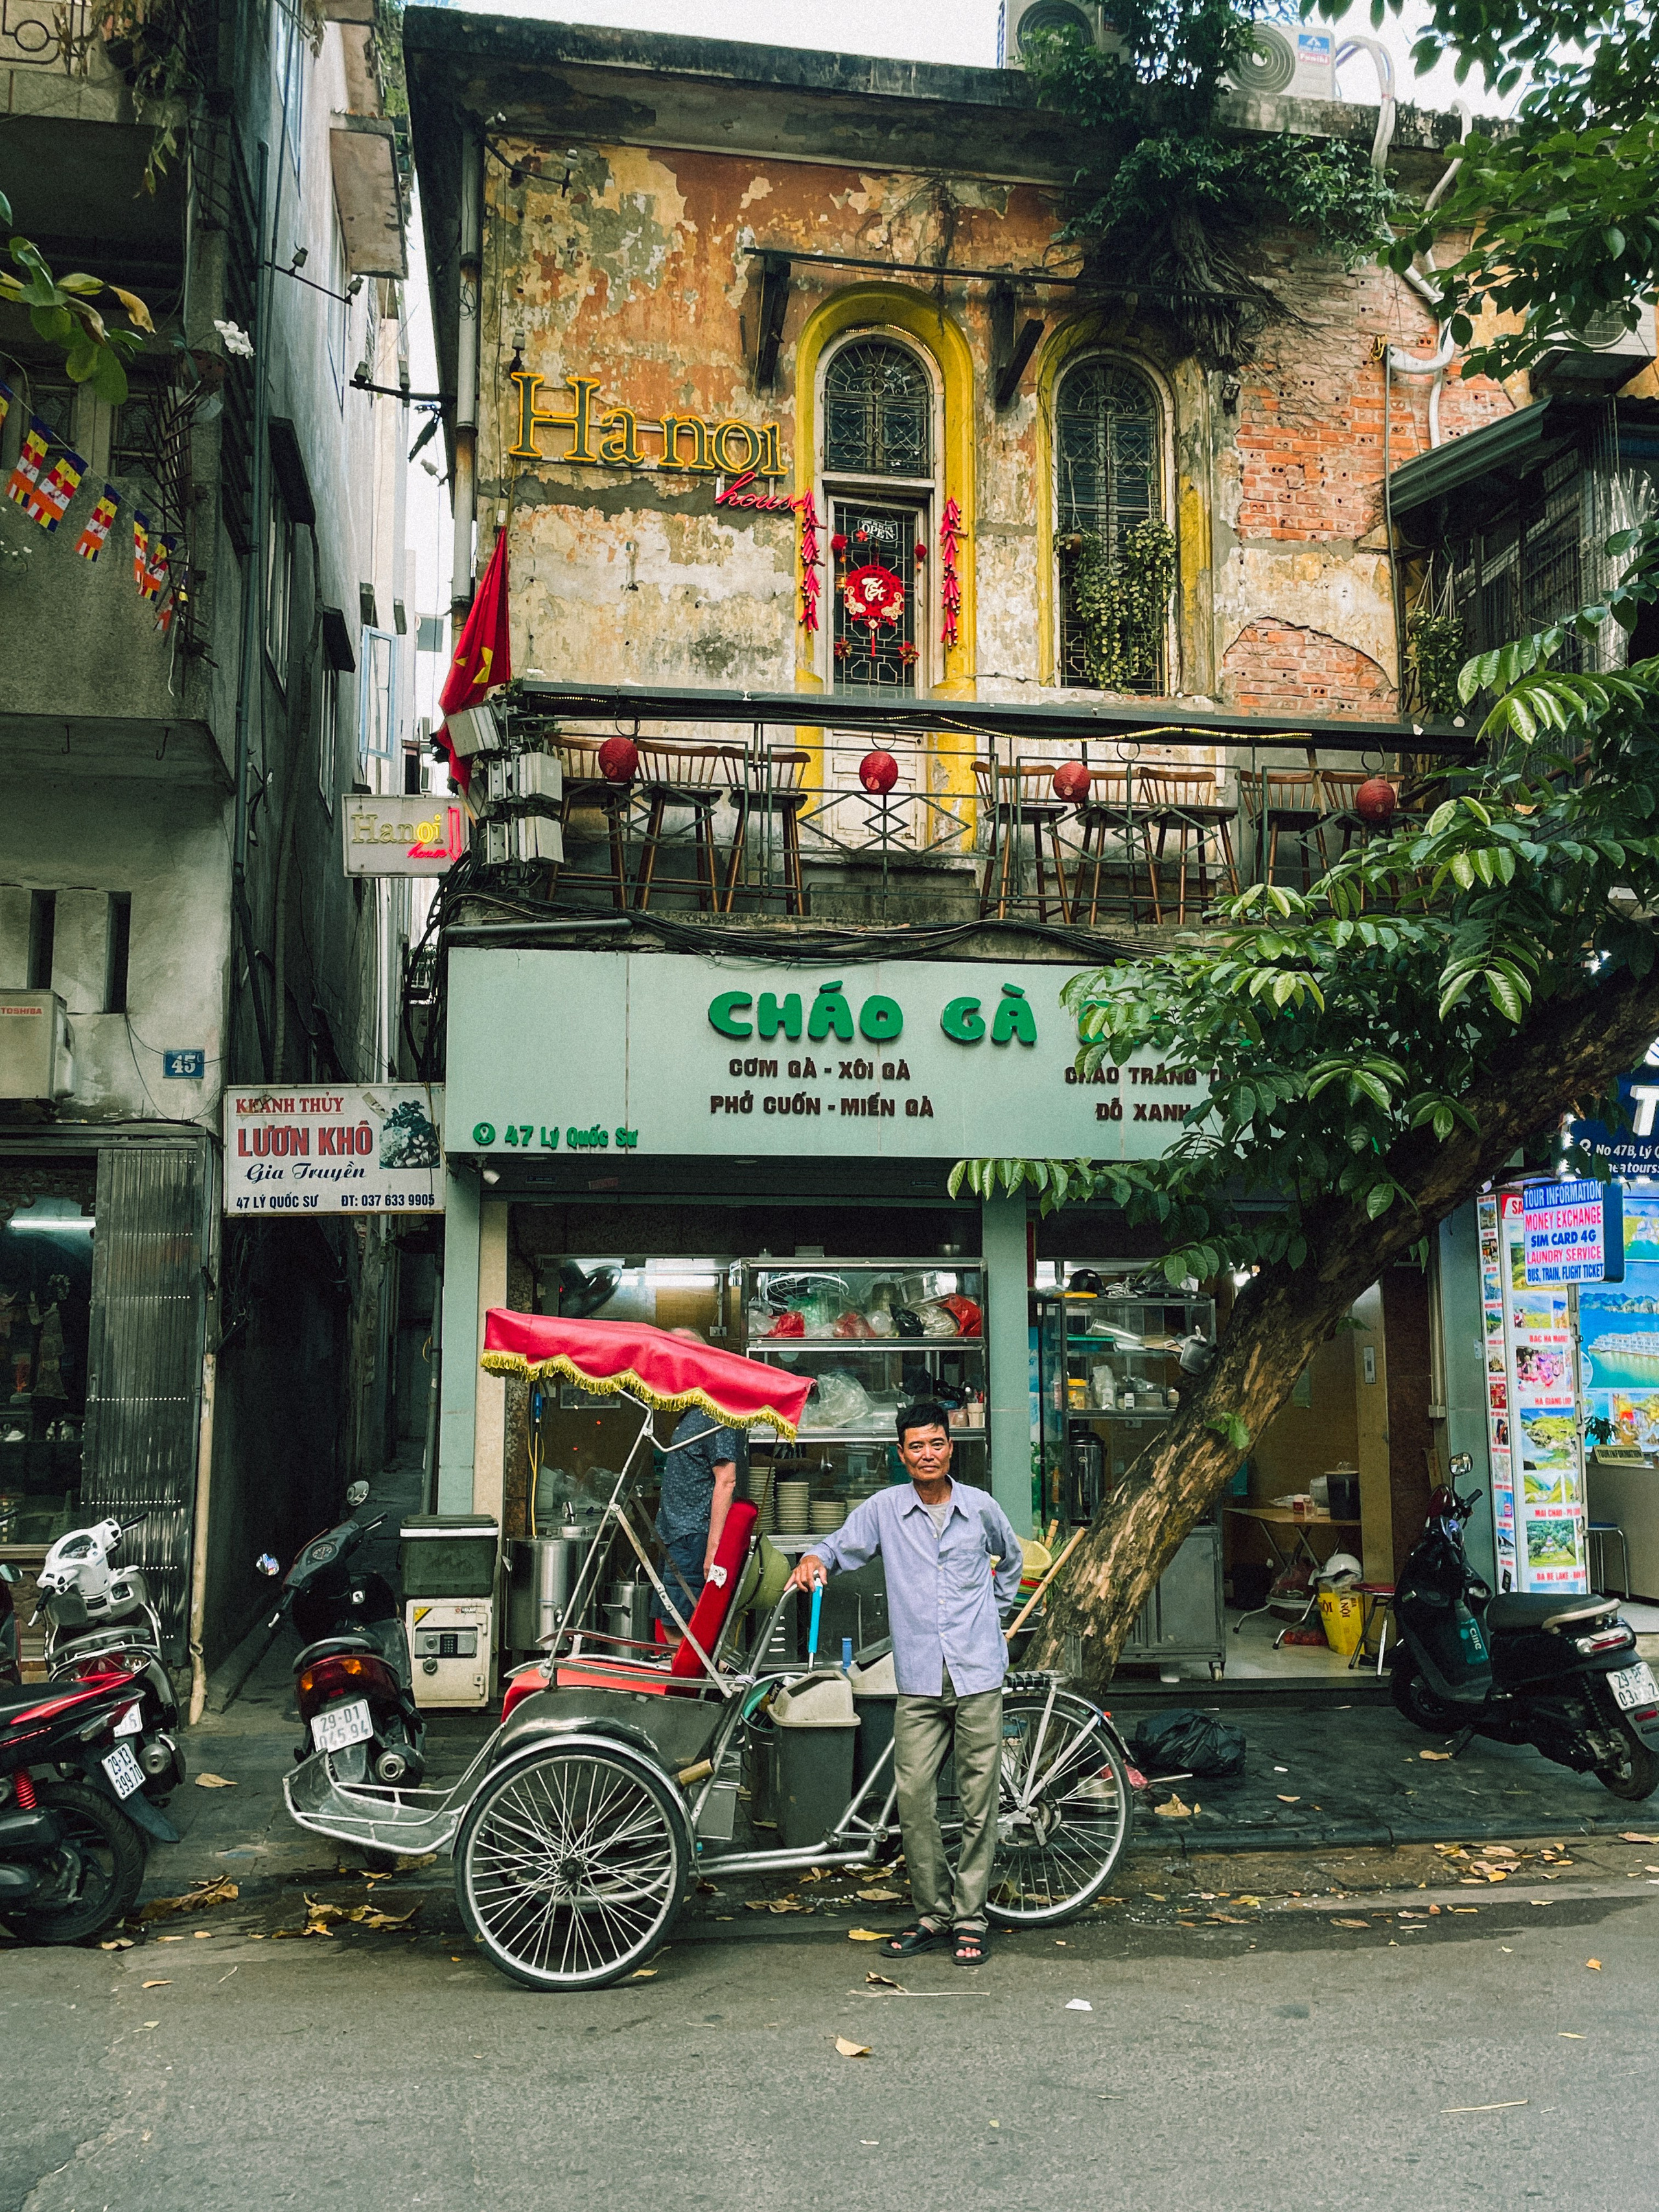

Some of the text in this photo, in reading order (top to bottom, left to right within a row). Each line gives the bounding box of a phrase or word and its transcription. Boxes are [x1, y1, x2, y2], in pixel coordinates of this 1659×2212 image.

[715, 472, 808, 513] house
[862, 523, 894, 539] OPEN
[351, 813, 444, 844] Hanoi
[708, 979, 904, 1042] CHÁO
[941, 982, 1038, 1045] GÀ
[729, 1058, 778, 1077] CƠM
[789, 1057, 817, 1078] GÀ
[839, 1058, 874, 1080] XÔI
[882, 1059, 911, 1080] GÀ
[299, 1092, 345, 1113] THỦY
[710, 1090, 754, 1115] PHỞ
[763, 1091, 820, 1115] CUỐN
[841, 1093, 895, 1117] MIẾN
[905, 1096, 934, 1119] GÀ
[1095, 1097, 1192, 1122] ĐỖ XANH
[237, 1120, 373, 1158] LƯƠN KHÔ
[504, 1124, 638, 1150] 47 Lý Quốc Sư
[1595, 1144, 1612, 1156] No
[1613, 1145, 1637, 1159] 47B,
[1639, 1145, 1653, 1159] Lý
[245, 1161, 367, 1185] Gia Truyền
[236, 1191, 435, 1209] 47 LÝ QUỐC SƯ ĐT: 037 633 9905
[1524, 1180, 1603, 1208] TOUR INFORMATION
[1511, 1200, 1524, 1215] SA
[1525, 1205, 1602, 1231] MONEY EXCHANGE
[1531, 1229, 1597, 1248] SIM CARD 4G
[1527, 1246, 1602, 1264] LAUNDRY SERVICE
[1527, 1263, 1604, 1283] BUS, TRAIN, FLIGHT TICKET
[319, 1705, 360, 1733] 29-D1
[108, 1747, 132, 1776] 29-X3
